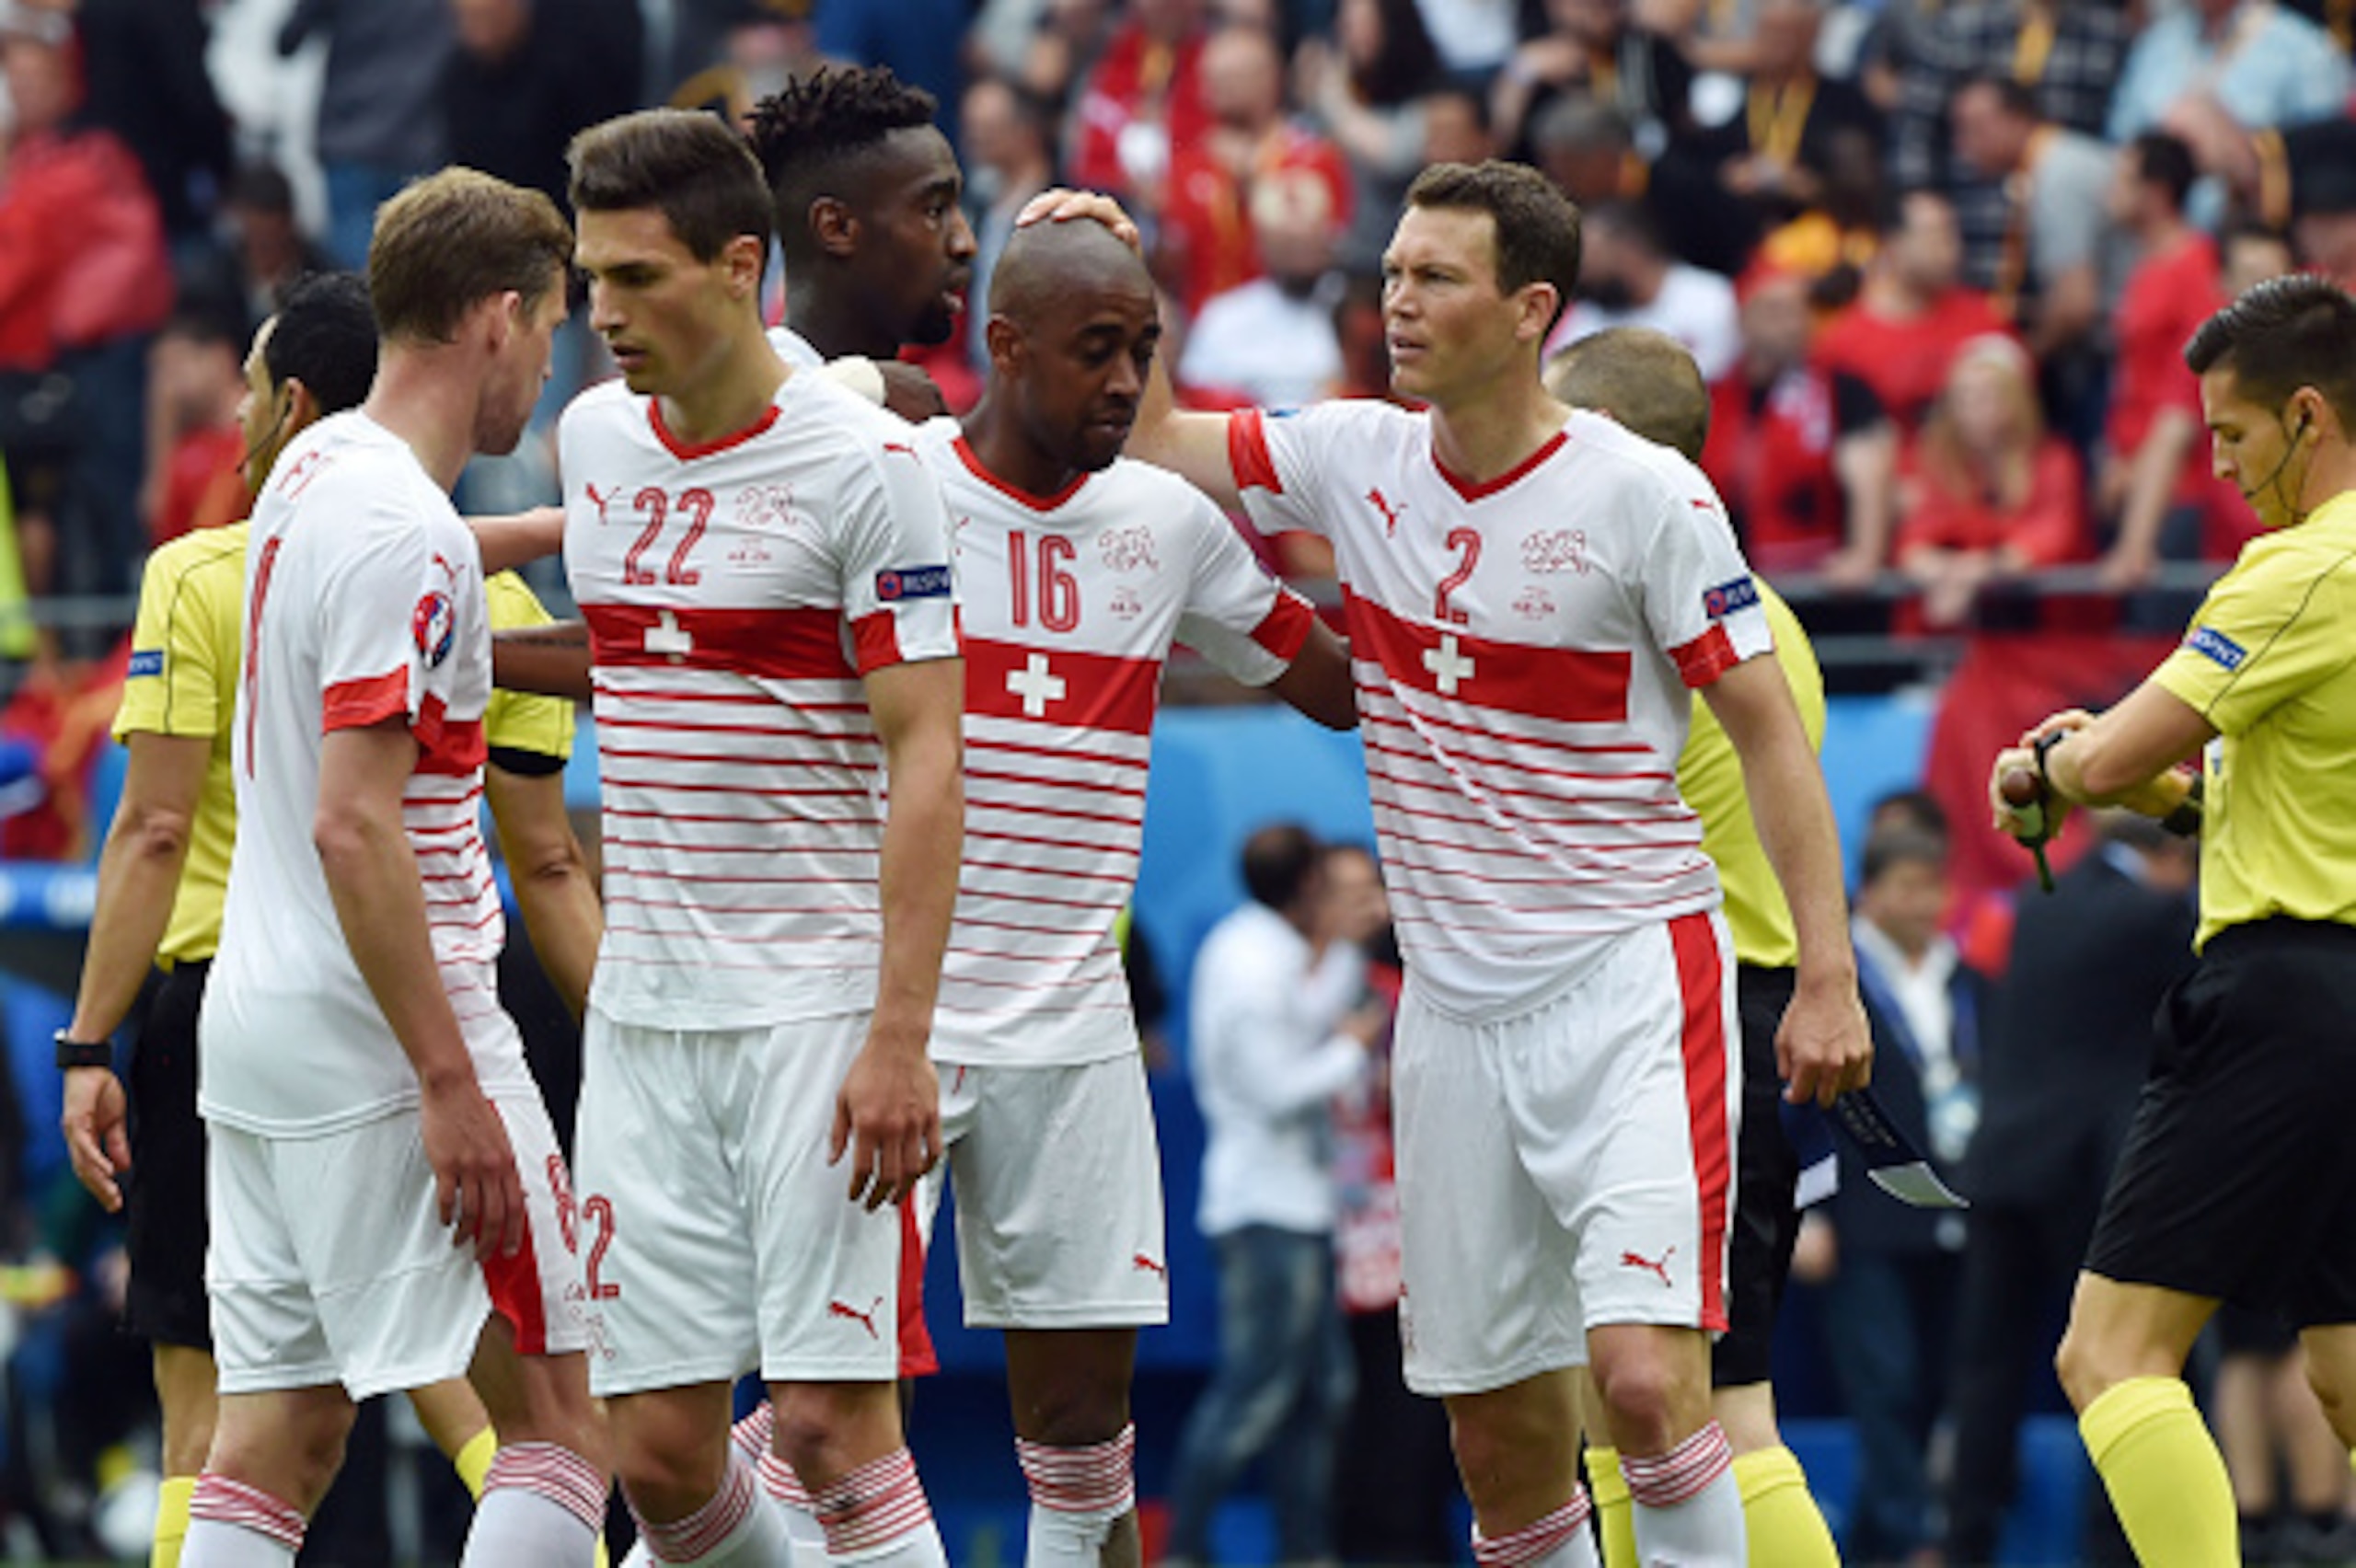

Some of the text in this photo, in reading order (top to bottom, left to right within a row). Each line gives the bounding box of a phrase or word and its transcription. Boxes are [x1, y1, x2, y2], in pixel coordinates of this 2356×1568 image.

[622, 487, 715, 584] 22
[1008, 530, 1081, 633] 16
[1435, 525, 1482, 624] 2
[583, 1193, 621, 1301] 2
